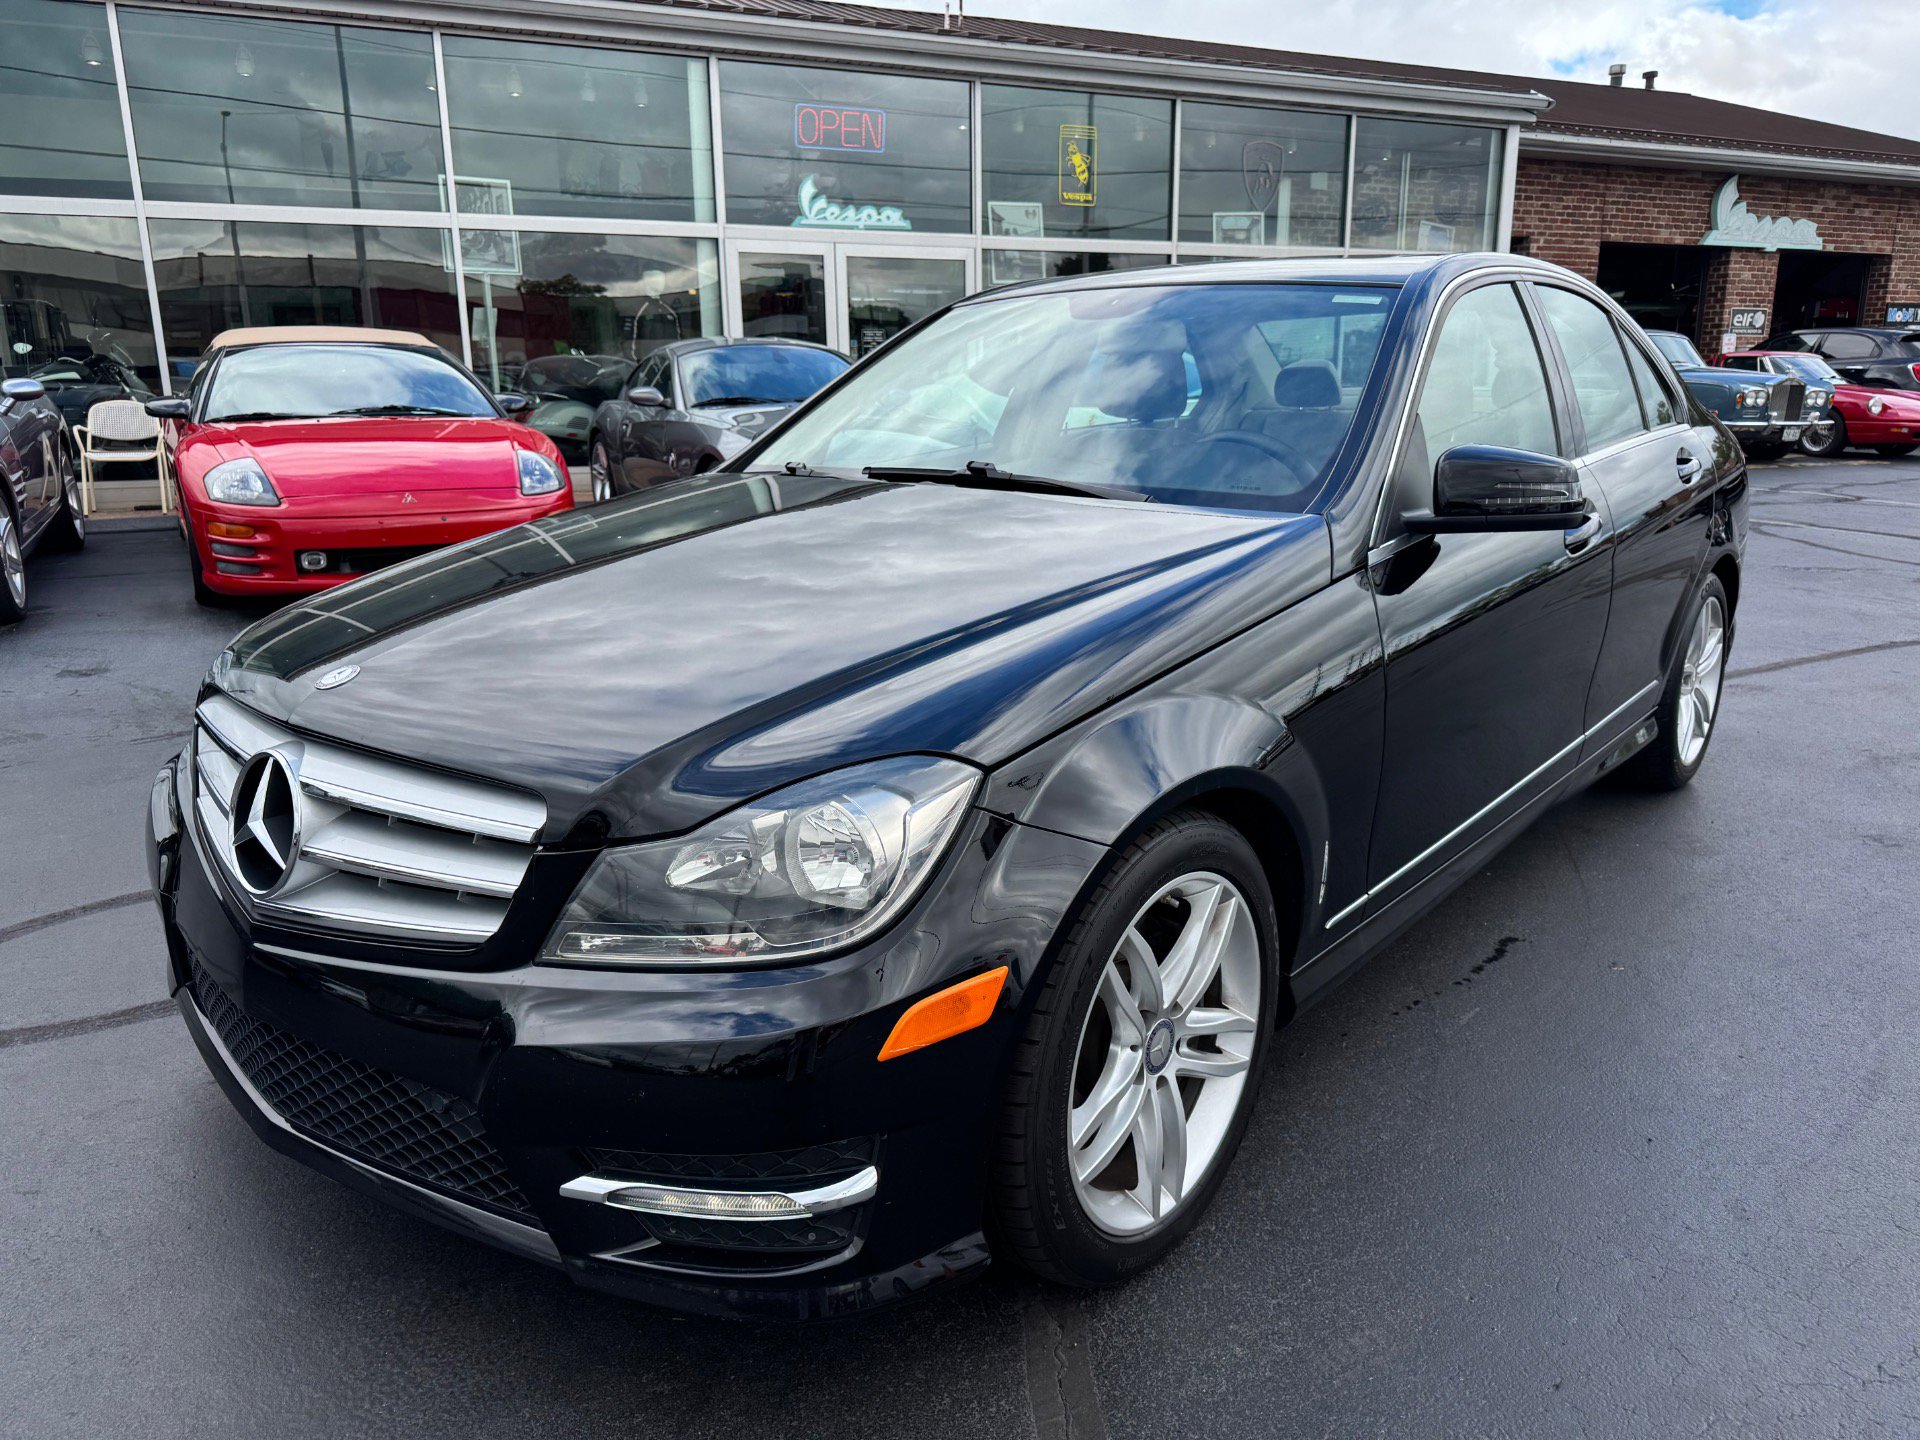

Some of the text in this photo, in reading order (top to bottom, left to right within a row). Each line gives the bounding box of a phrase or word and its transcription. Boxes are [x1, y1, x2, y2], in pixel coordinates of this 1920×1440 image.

[799, 108, 881, 148] OPEN
[797, 174, 911, 229] Vespa
[1733, 312, 1754, 327] elf
